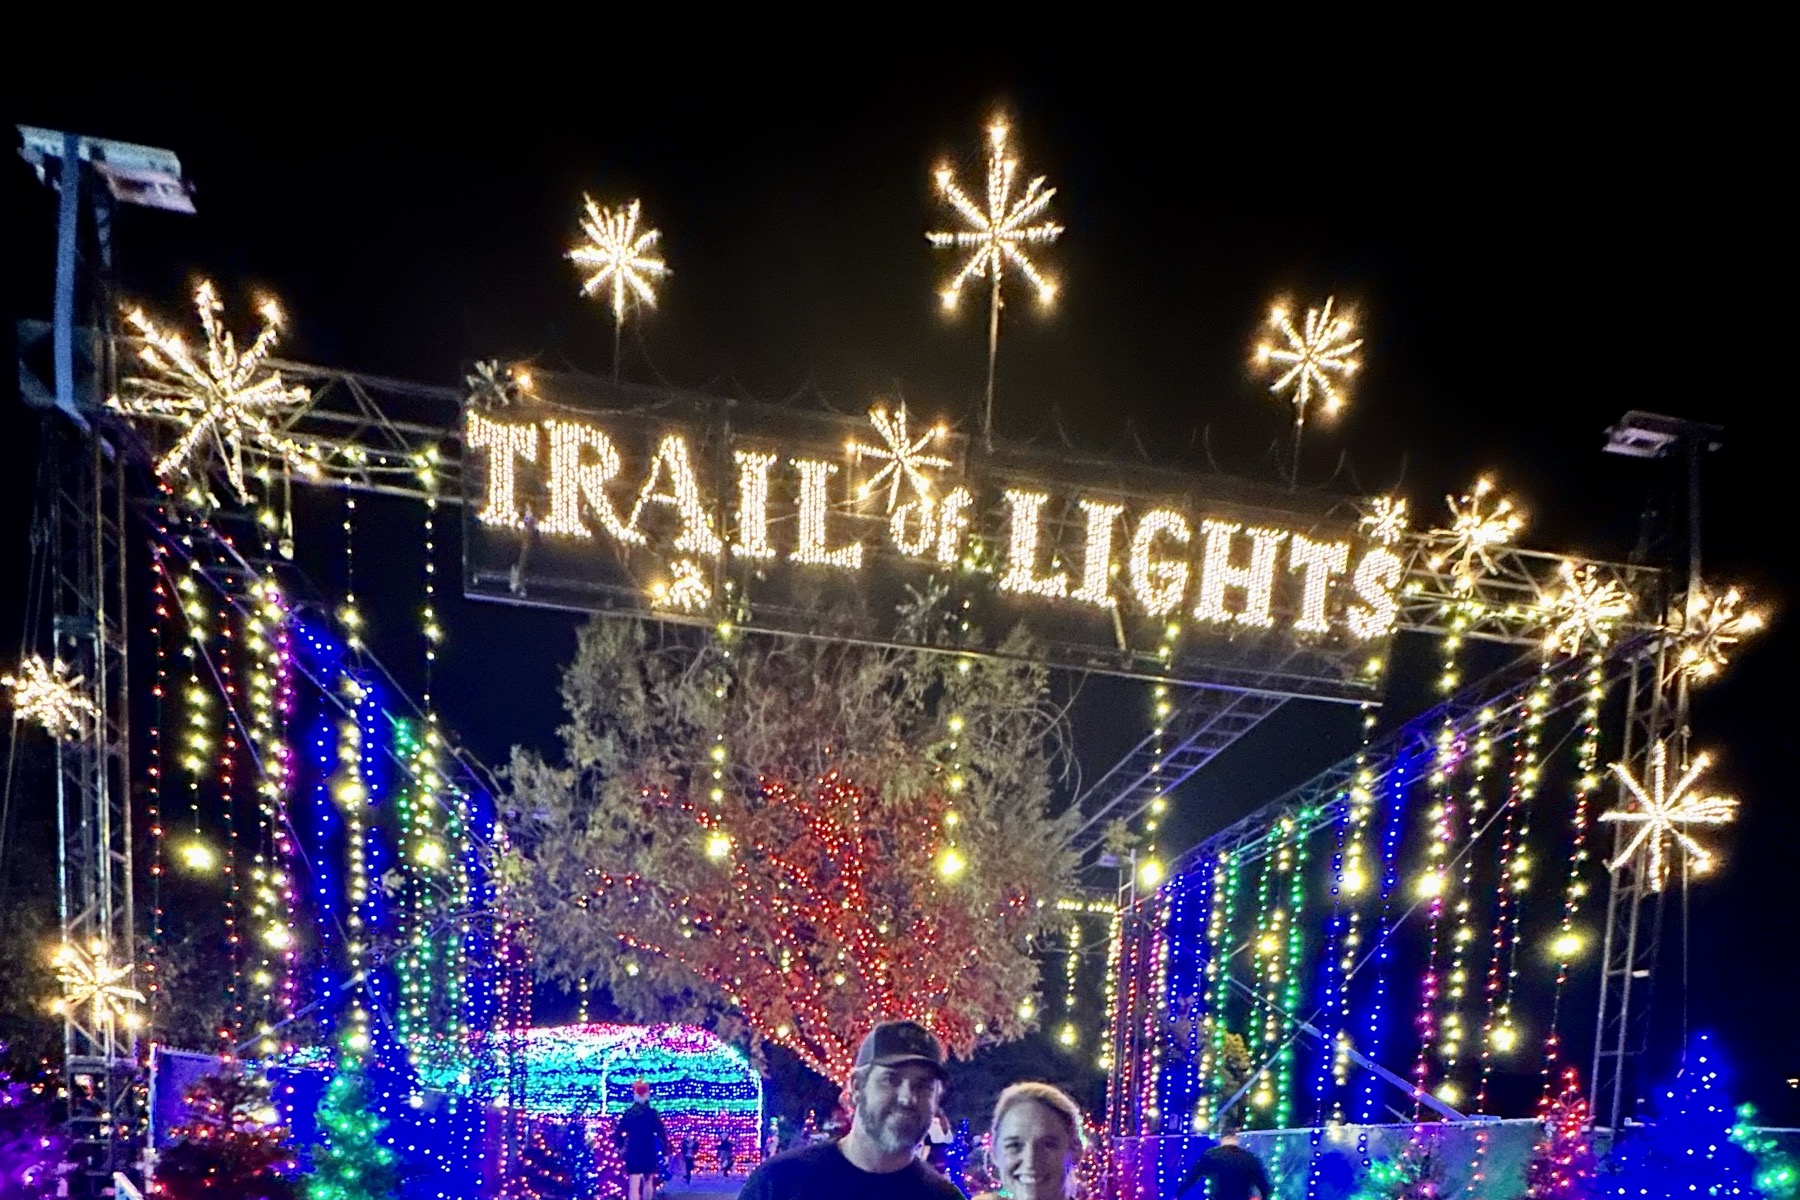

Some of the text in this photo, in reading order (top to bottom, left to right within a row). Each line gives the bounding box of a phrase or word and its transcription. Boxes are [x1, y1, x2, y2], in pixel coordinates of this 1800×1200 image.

[466, 409, 1402, 642] TRAIL of LIGHTS
